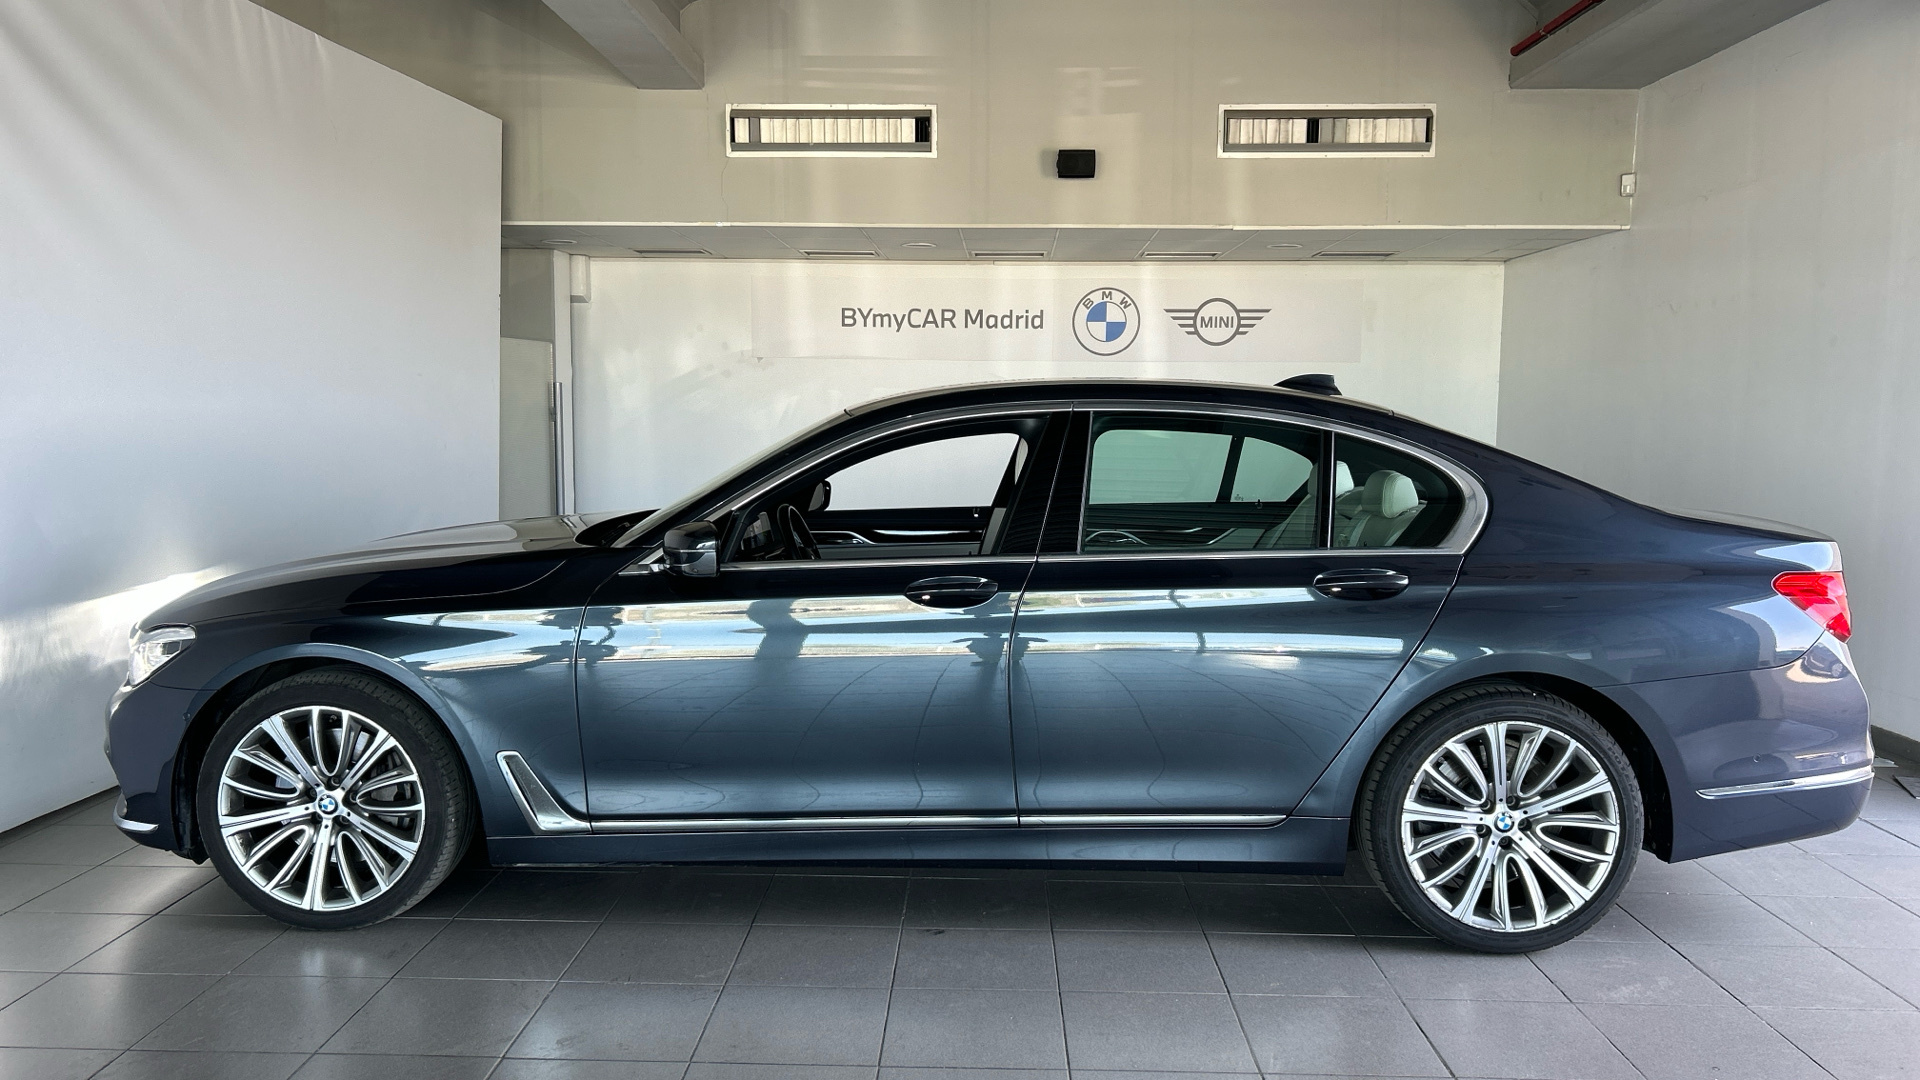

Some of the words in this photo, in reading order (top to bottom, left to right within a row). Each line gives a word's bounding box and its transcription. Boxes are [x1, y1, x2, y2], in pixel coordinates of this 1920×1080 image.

[1082, 291, 1132, 310] BMW
[841, 307, 956, 332] BYmyCAR
[965, 307, 1044, 330] Madrid
[1200, 316, 1234, 328] MINI
